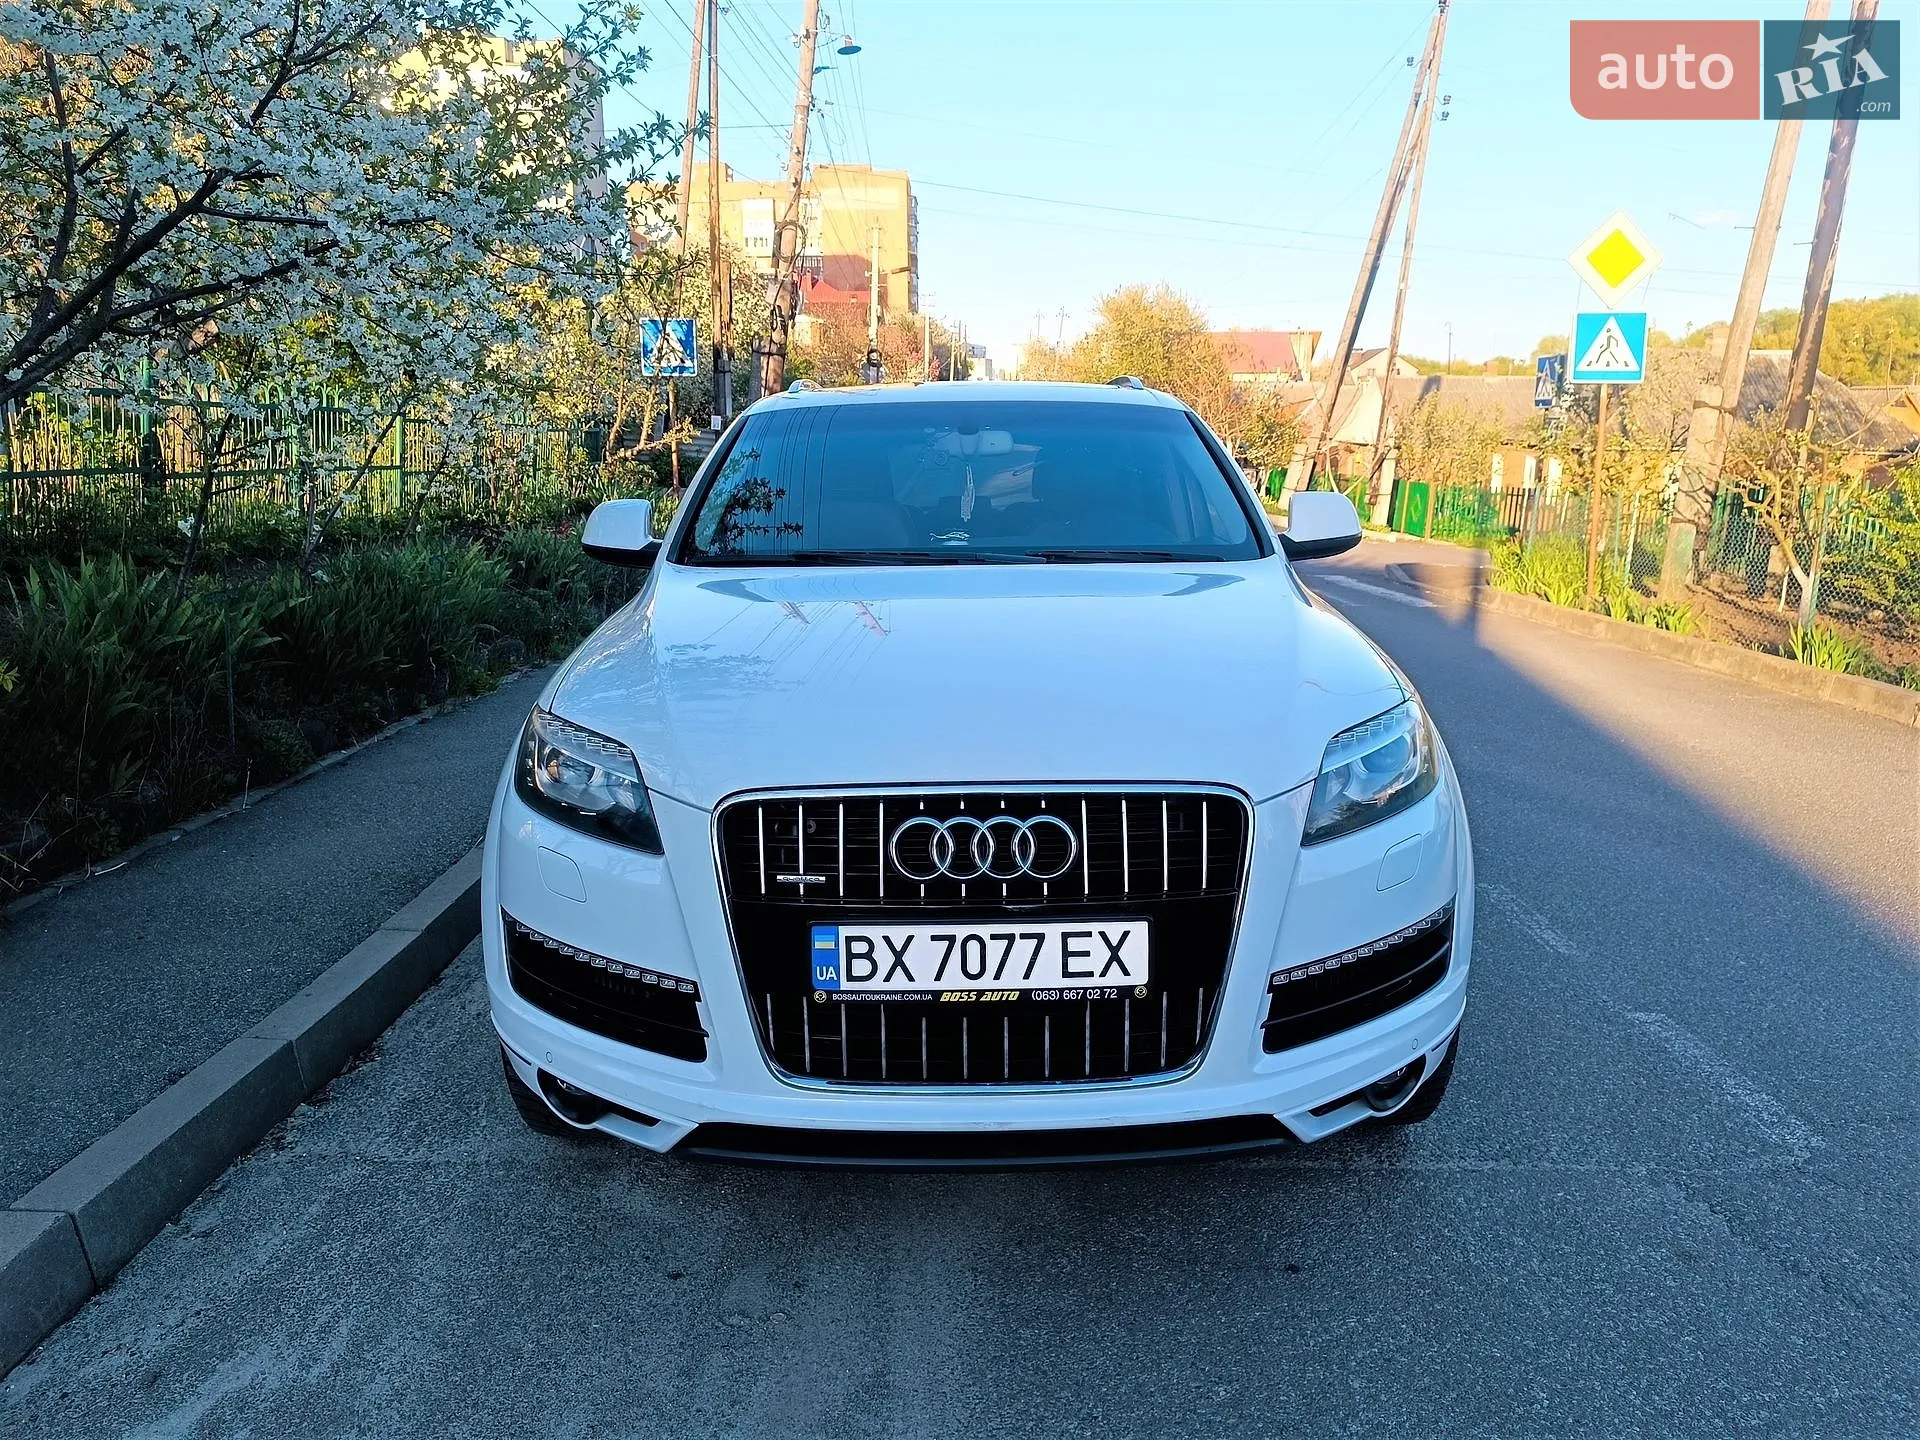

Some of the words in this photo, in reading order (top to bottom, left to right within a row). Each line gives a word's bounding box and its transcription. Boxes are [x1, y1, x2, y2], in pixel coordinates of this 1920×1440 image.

[844, 934, 916, 983] BX
[930, 932, 1046, 982] 7077
[1060, 929, 1132, 979] EX
[816, 965, 838, 981] UA
[832, 992, 933, 1001] BOSSAUTOUKRAINE.COM.UA
[939, 991, 978, 1002] BOSS
[979, 990, 1021, 1001] AUTO
[1031, 989, 1060, 1000] (063)
[1063, 989, 1083, 1000] 667
[1086, 988, 1101, 1000] 02
[1103, 988, 1118, 999] 72
